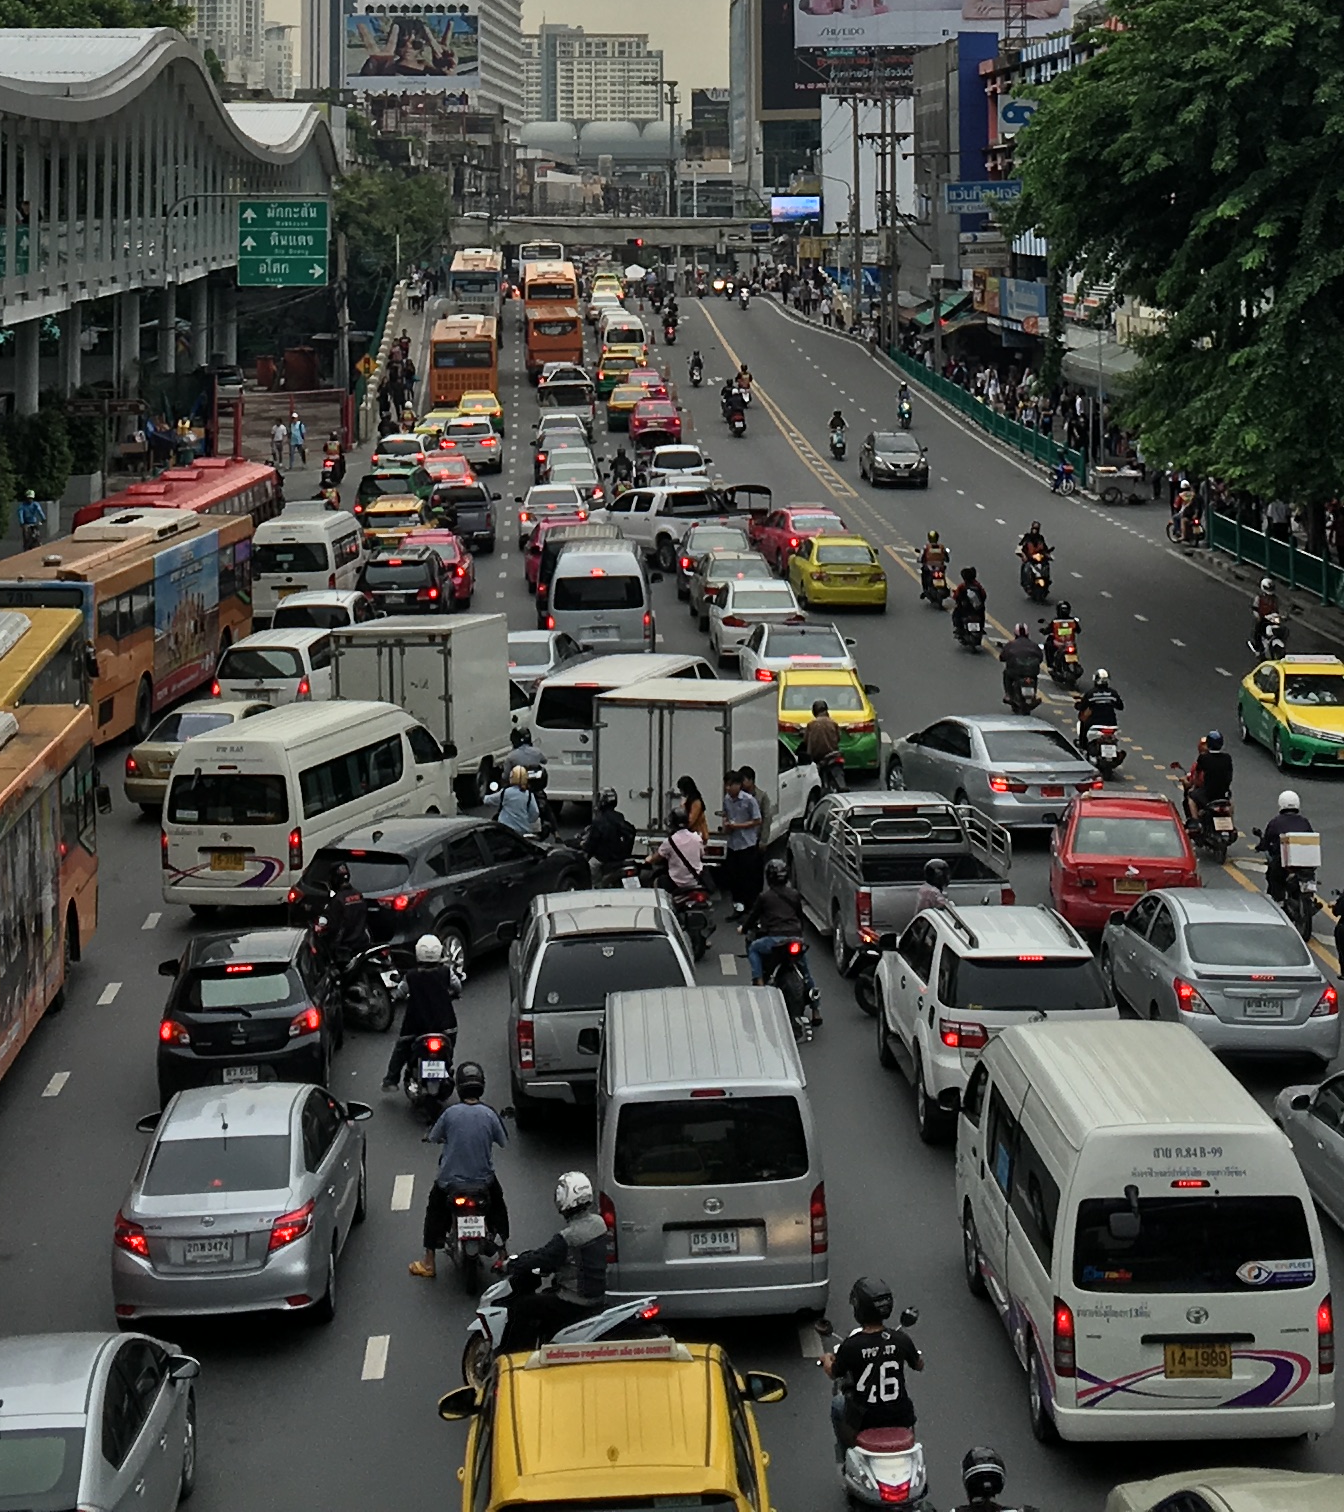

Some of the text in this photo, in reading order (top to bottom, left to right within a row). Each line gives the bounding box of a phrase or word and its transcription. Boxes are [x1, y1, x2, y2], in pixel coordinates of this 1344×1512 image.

[818, 27, 865, 37] SHISEIDO
[266, 202, 317, 218] มักกะสัน
[269, 231, 314, 246] ดินแดง
[258, 257, 290, 274] อโศก
[710, 1232, 735, 1244] 9181
[1170, 1350, 1228, 1368] 14-1989
